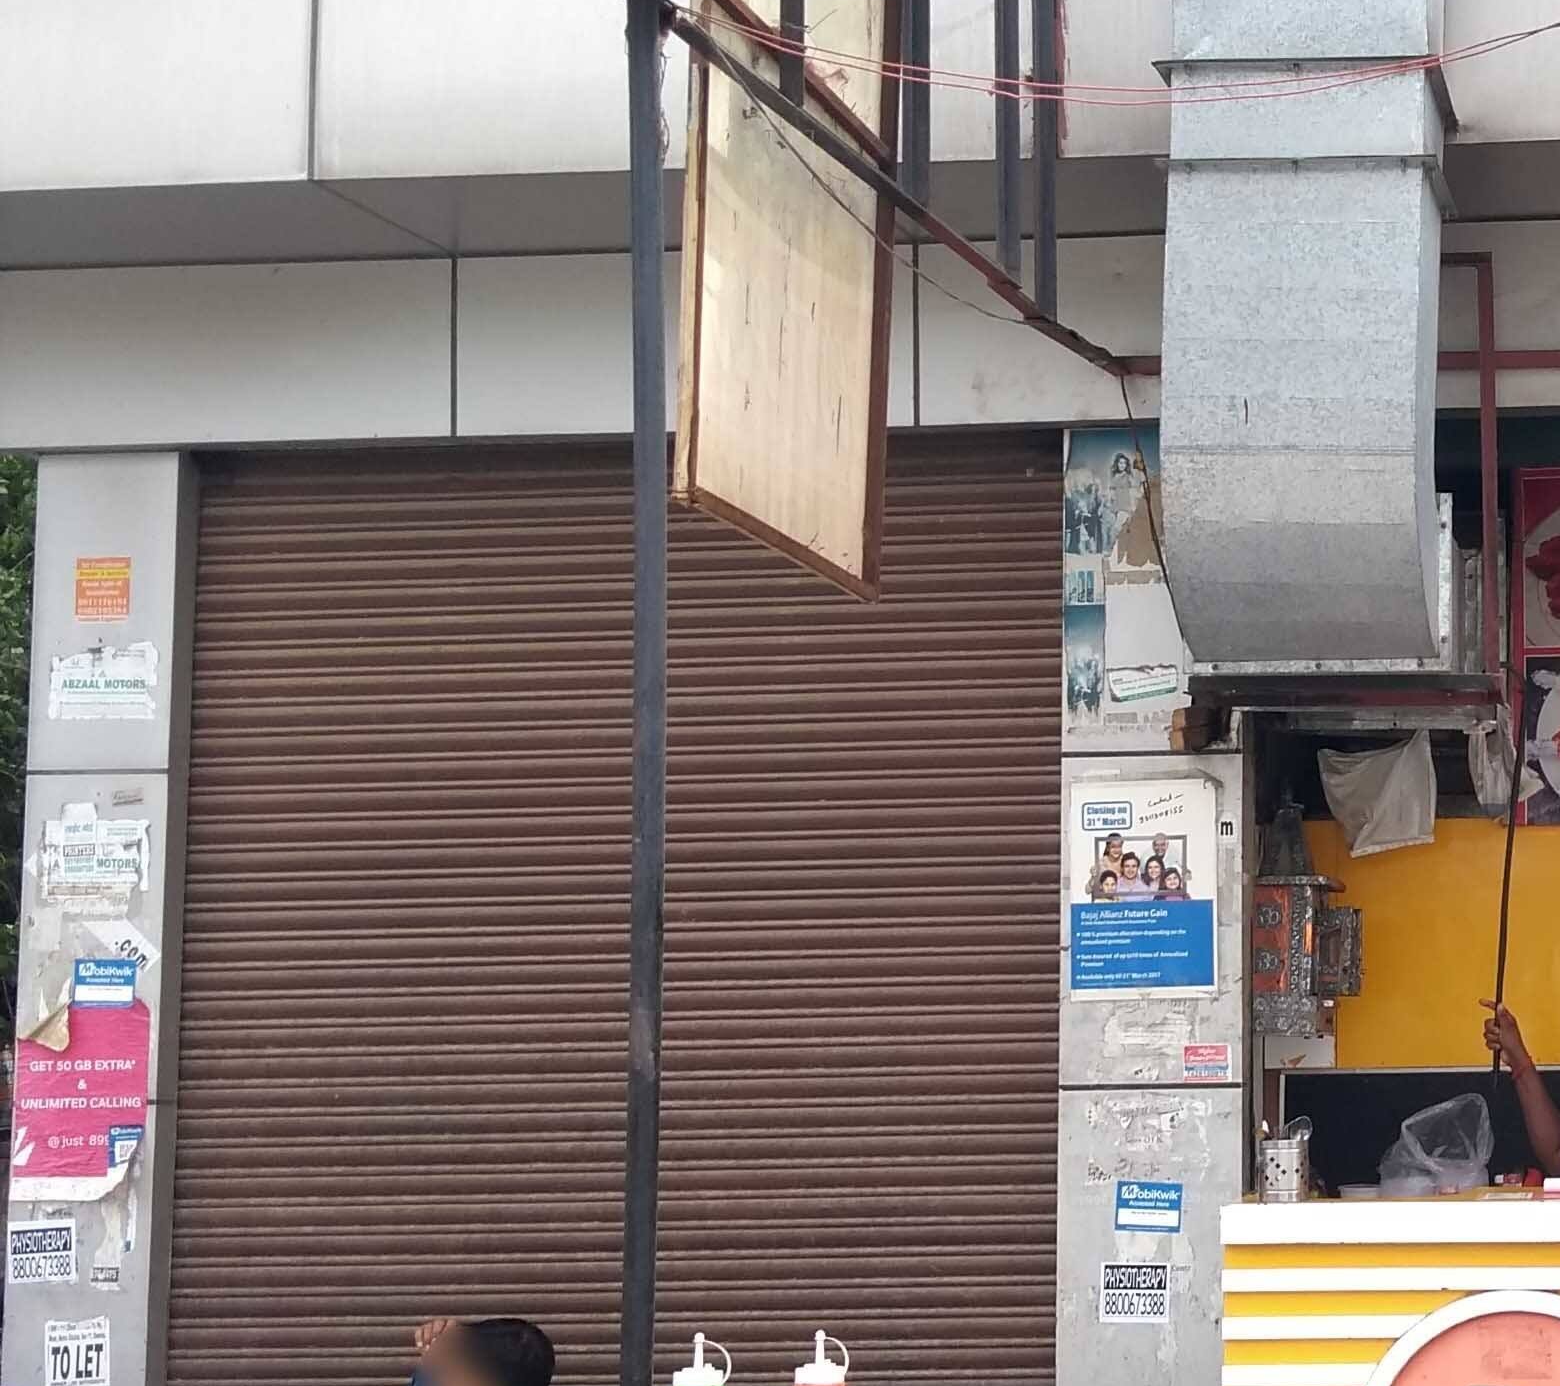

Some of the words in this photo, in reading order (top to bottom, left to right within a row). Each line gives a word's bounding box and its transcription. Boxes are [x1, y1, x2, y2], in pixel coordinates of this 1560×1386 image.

[103, 678, 147, 689] MOTORS
[29, 1060, 54, 1072] GET
[56, 1060, 72, 1072] 50
[74, 1059, 92, 1072] GB
[77, 1077, 88, 1091] &
[21, 1097, 87, 1110] UNLIMITED
[89, 1096, 142, 1109] CALLING
[61, 1134, 84, 1148] just
[1121, 1183, 1181, 1201] MobiKwik
[11, 1228, 72, 1254] PHYSIOTHERAPY
[12, 1254, 71, 1280] 8800673388
[1104, 1266, 1167, 1289] PHYSIOTHERAPY
[1104, 1292, 1165, 1316] 8800673388
[51, 1345, 71, 1381] TO
[75, 1342, 104, 1379] LET
